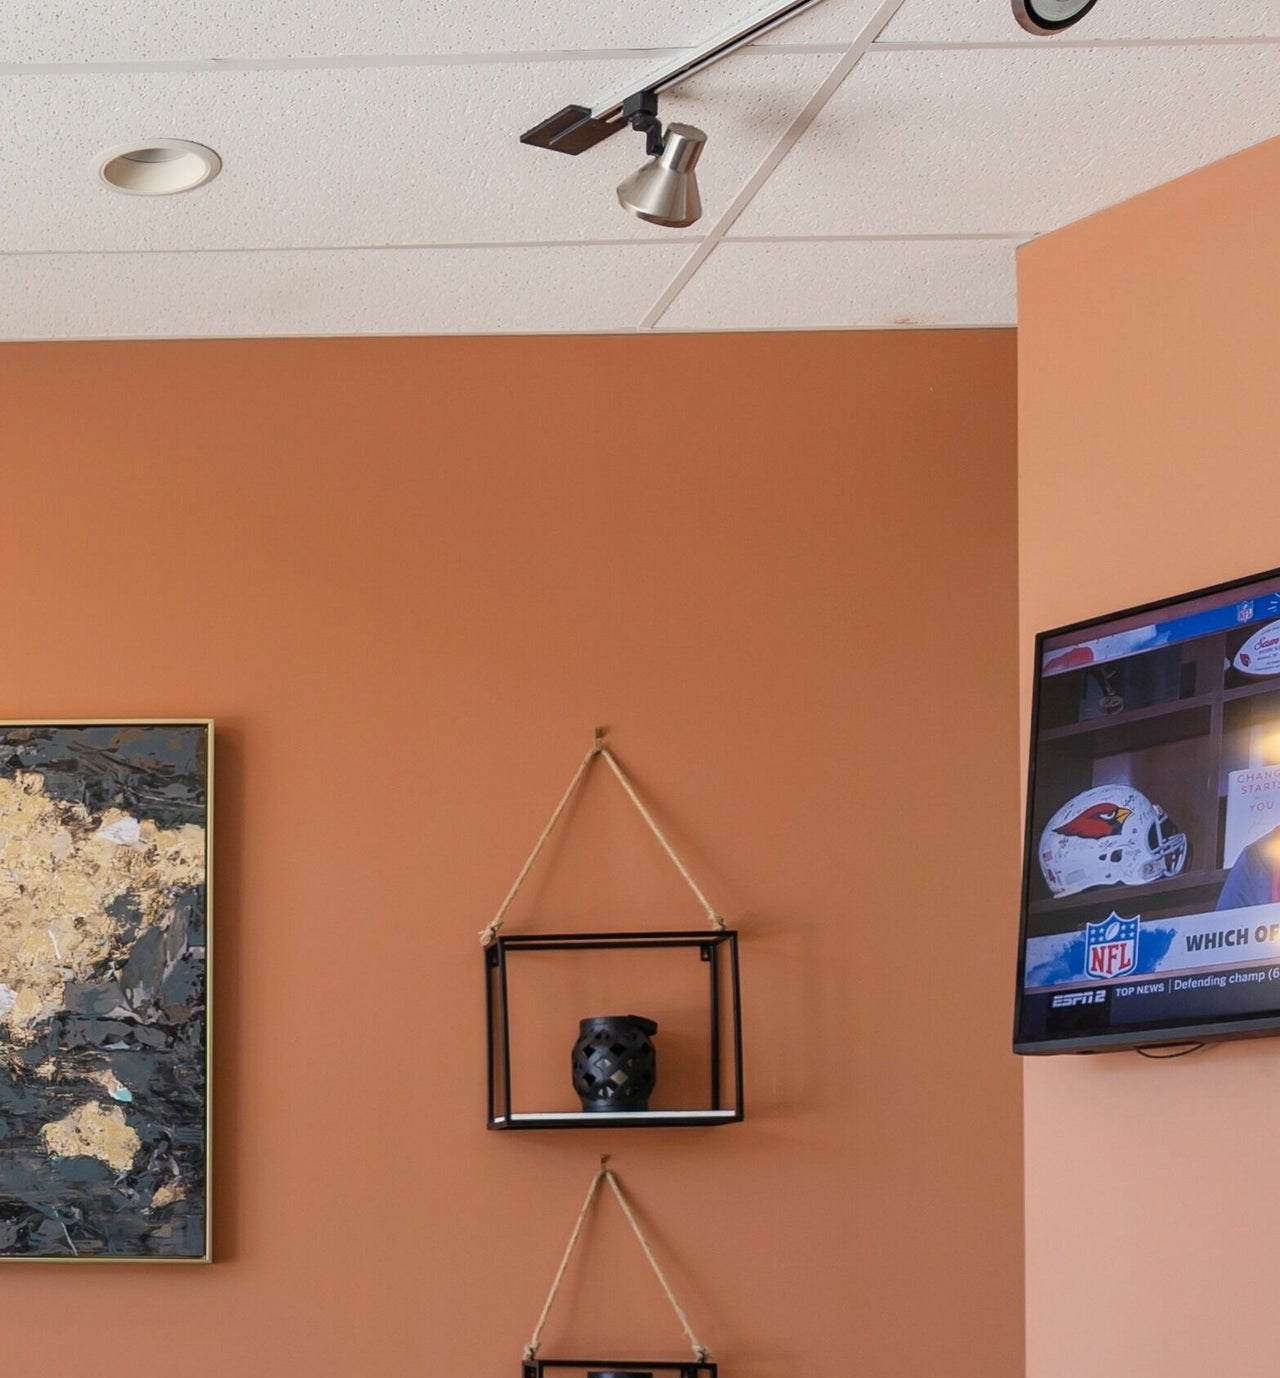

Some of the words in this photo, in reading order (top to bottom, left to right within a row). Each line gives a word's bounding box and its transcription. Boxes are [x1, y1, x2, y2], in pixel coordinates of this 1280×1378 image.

[1249, 801, 1274, 812] YOU
[1186, 928, 1249, 952] WHICH
[1254, 924, 1280, 943] OF
[1090, 943, 1132, 974] NFL
[1115, 987, 1135, 997] TOP
[1136, 983, 1165, 995] NEWS
[1174, 975, 1226, 990] Defending
[1229, 972, 1266, 983] champ
